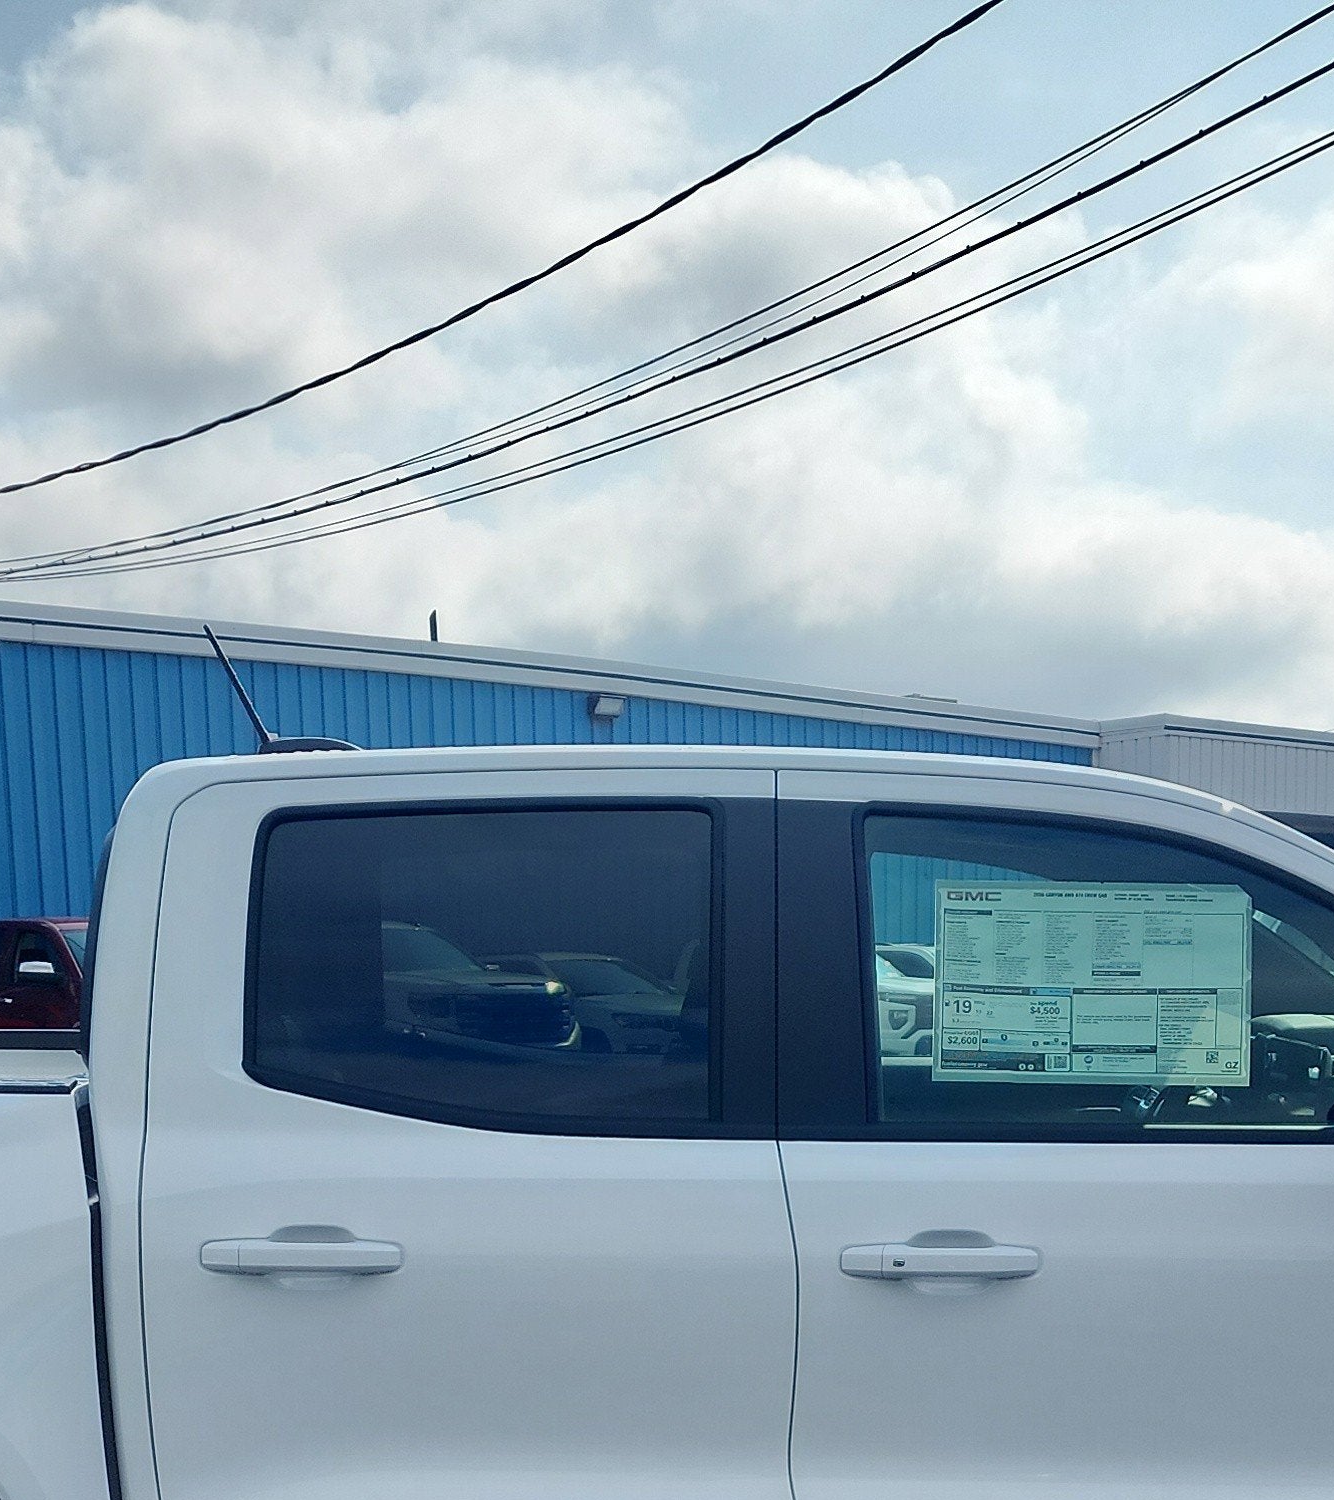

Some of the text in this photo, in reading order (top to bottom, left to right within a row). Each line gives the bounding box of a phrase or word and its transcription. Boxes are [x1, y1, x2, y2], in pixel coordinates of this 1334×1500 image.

[947, 891, 1002, 901] GMC
[953, 999, 972, 1014] 19
[1030, 1006, 1061, 1015] $4,500
[947, 1036, 978, 1045] $2,600
